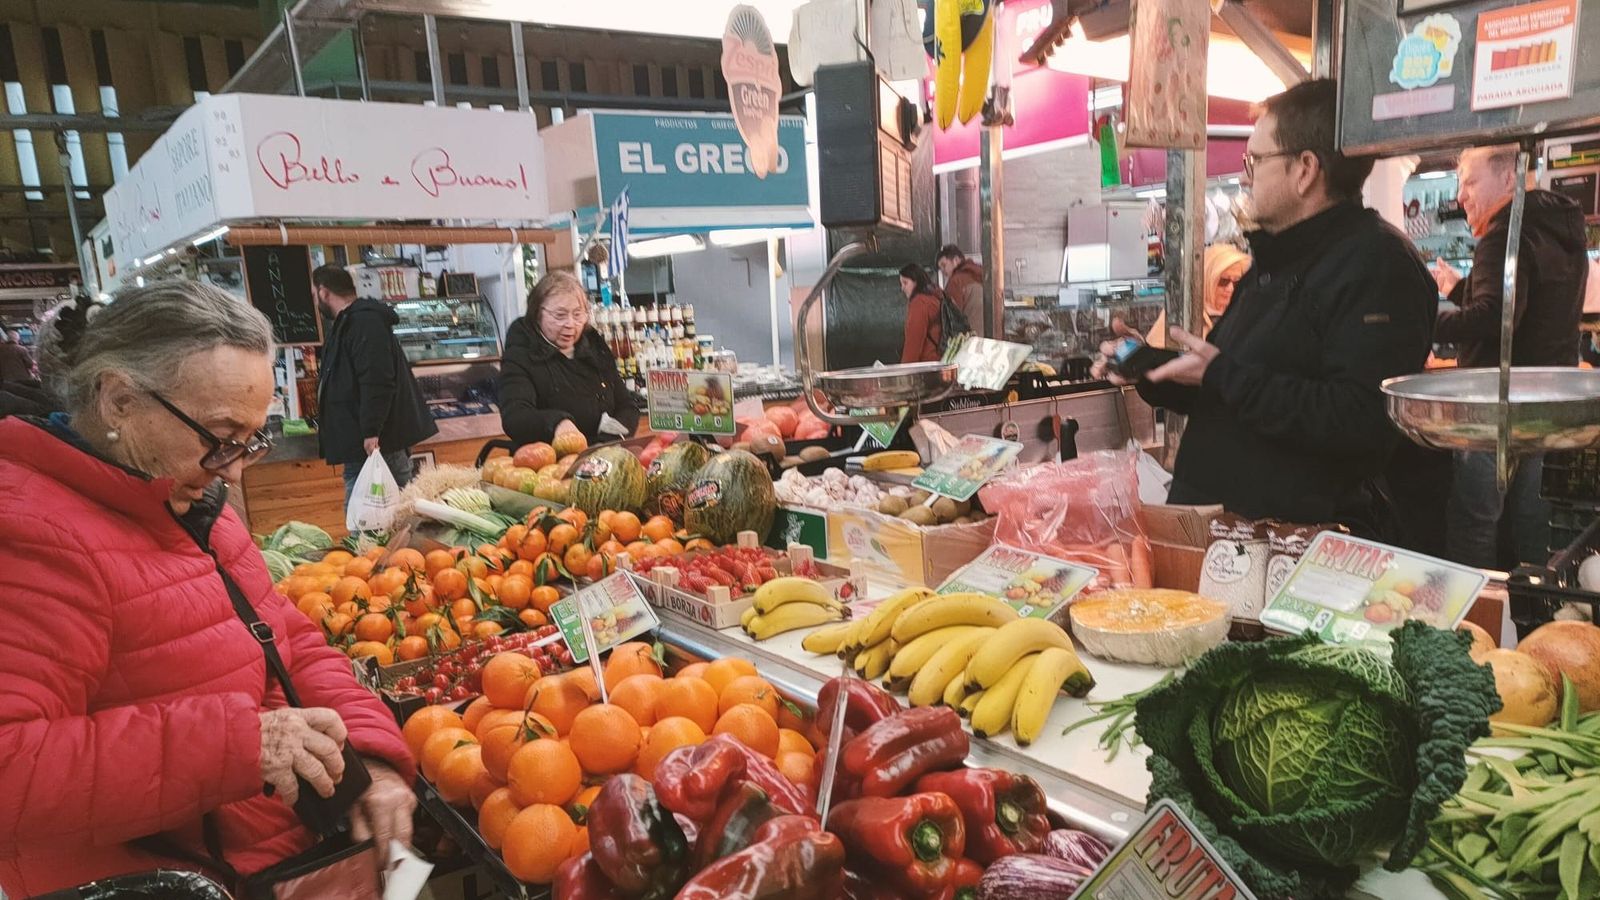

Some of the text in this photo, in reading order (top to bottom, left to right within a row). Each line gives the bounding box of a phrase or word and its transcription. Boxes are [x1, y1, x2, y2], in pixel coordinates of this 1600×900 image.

[741, 84, 769, 110] Green
[1477, 83, 1563, 101] PARADA ASOCIADA
[654, 118, 698, 129] PRODUCTOS
[618, 141, 667, 174] EL
[648, 370, 689, 392] FRUTAS
[1312, 535, 1395, 582] FRUTAS
[670, 596, 697, 619] BORJA
[1134, 810, 1237, 900] FRUT
